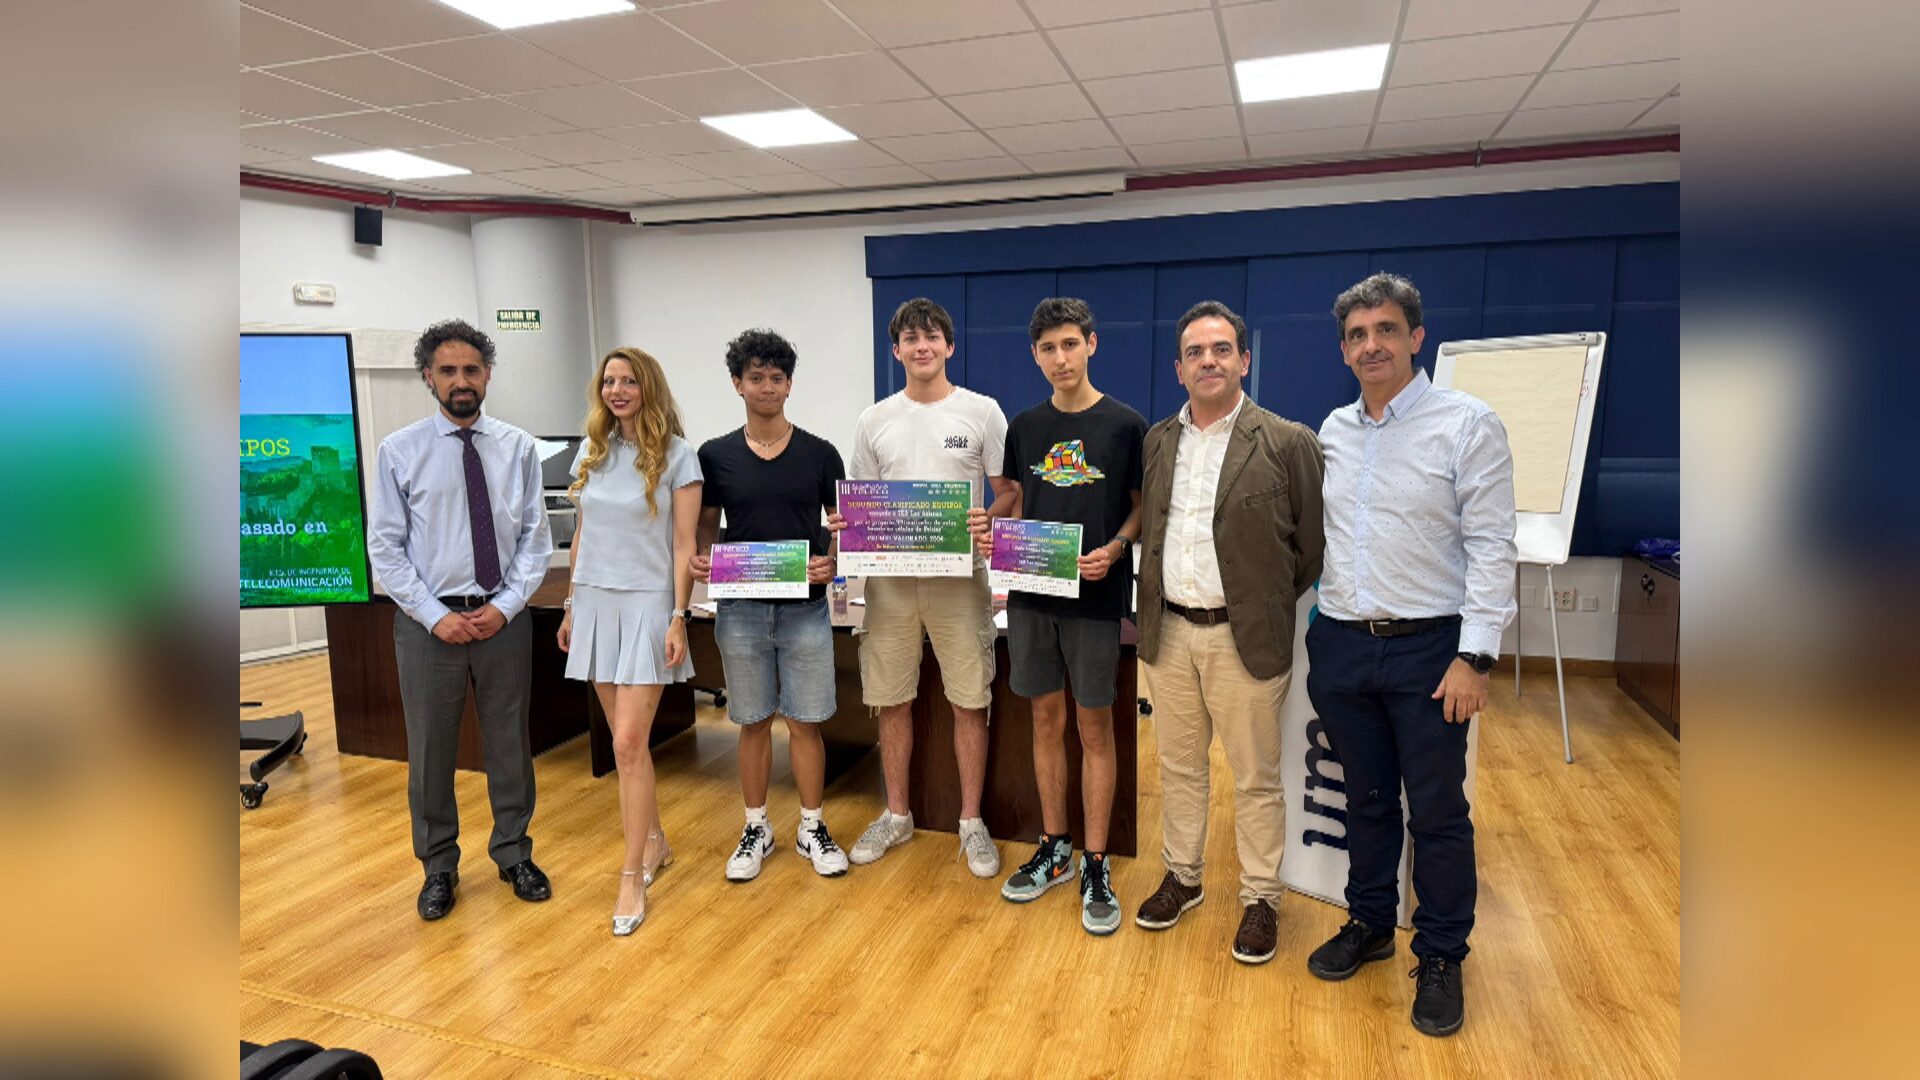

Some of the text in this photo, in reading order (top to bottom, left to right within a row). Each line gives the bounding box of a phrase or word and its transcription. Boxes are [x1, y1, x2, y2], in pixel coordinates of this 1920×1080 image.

[500, 311, 537, 320] SALIDA DE
[497, 321, 539, 330] EMERGENCIA
[883, 501, 931, 509] CLASIFICADO
[932, 501, 963, 509] EQUIPOS
[304, 521, 328, 533] en
[298, 565, 340, 576] INGENIERÍA
[240, 574, 352, 588] TELECOMUNICACIÓN
